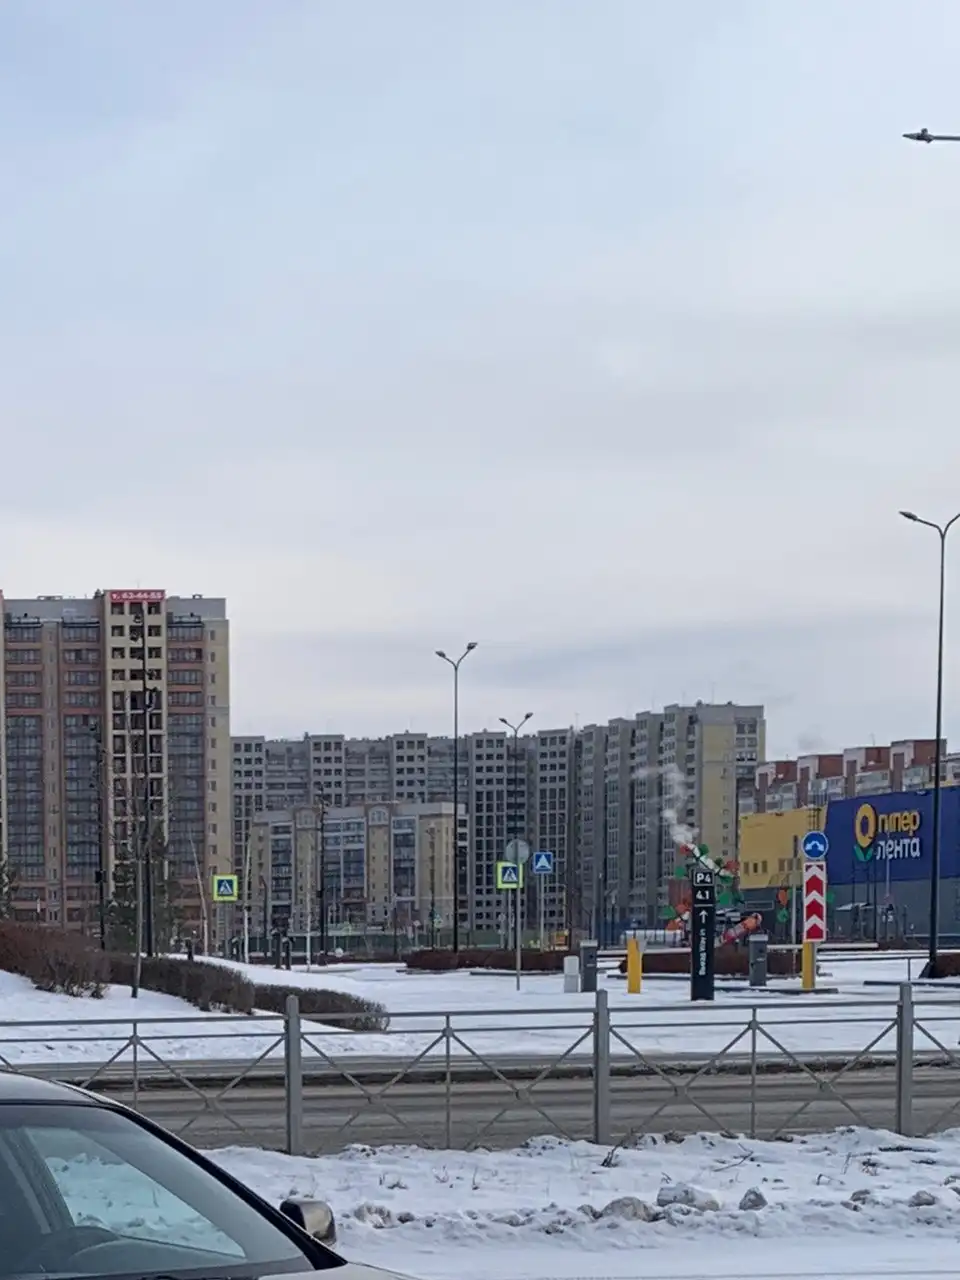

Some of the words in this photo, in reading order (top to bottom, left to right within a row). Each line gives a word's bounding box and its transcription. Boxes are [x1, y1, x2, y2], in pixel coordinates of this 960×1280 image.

[876, 837, 921, 860] лента
[696, 873, 711, 883] P4
[696, 890, 710, 900] 4.1
